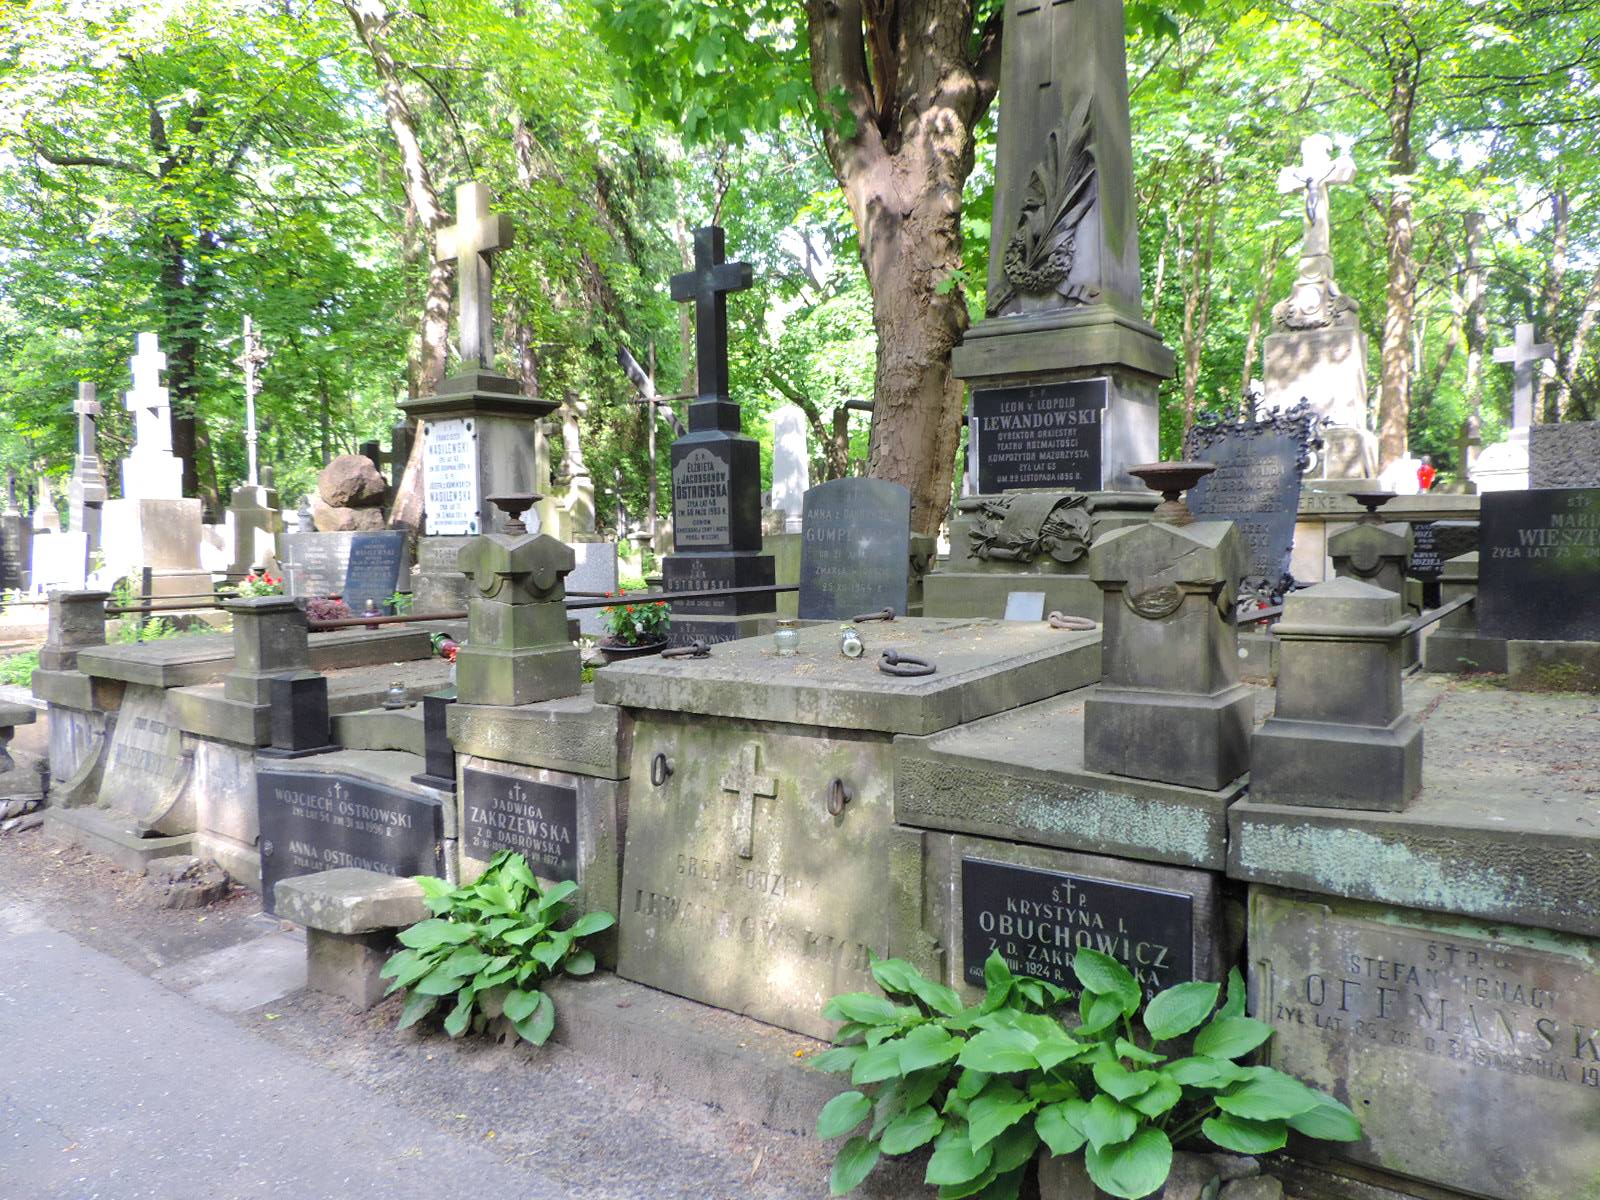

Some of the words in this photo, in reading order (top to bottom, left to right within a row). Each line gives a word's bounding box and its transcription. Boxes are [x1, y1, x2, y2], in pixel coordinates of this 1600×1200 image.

[1000, 402, 1024, 413] LEON
[1038, 397, 1075, 410] LEOPOLD
[983, 409, 1097, 431] LEWANDOWSKI
[676, 484, 727, 499] OSTROWSKA
[1528, 547, 1549, 558] LAT
[667, 578, 730, 590] OSTROWSKI
[275, 788, 332, 811] WOJCIECH
[339, 801, 412, 828] OSTROWSKI
[492, 798, 543, 819] JADWIGA
[471, 806, 570, 844] ZAKRZEWSKA
[288, 840, 317, 858] ANNA
[324, 849, 396, 876] OSTROWSKA
[1007, 896, 1104, 929] KRYSTYNA
[979, 911, 1169, 969] OBUCHOWICZ
[1315, 1014, 1342, 1033] LAT
